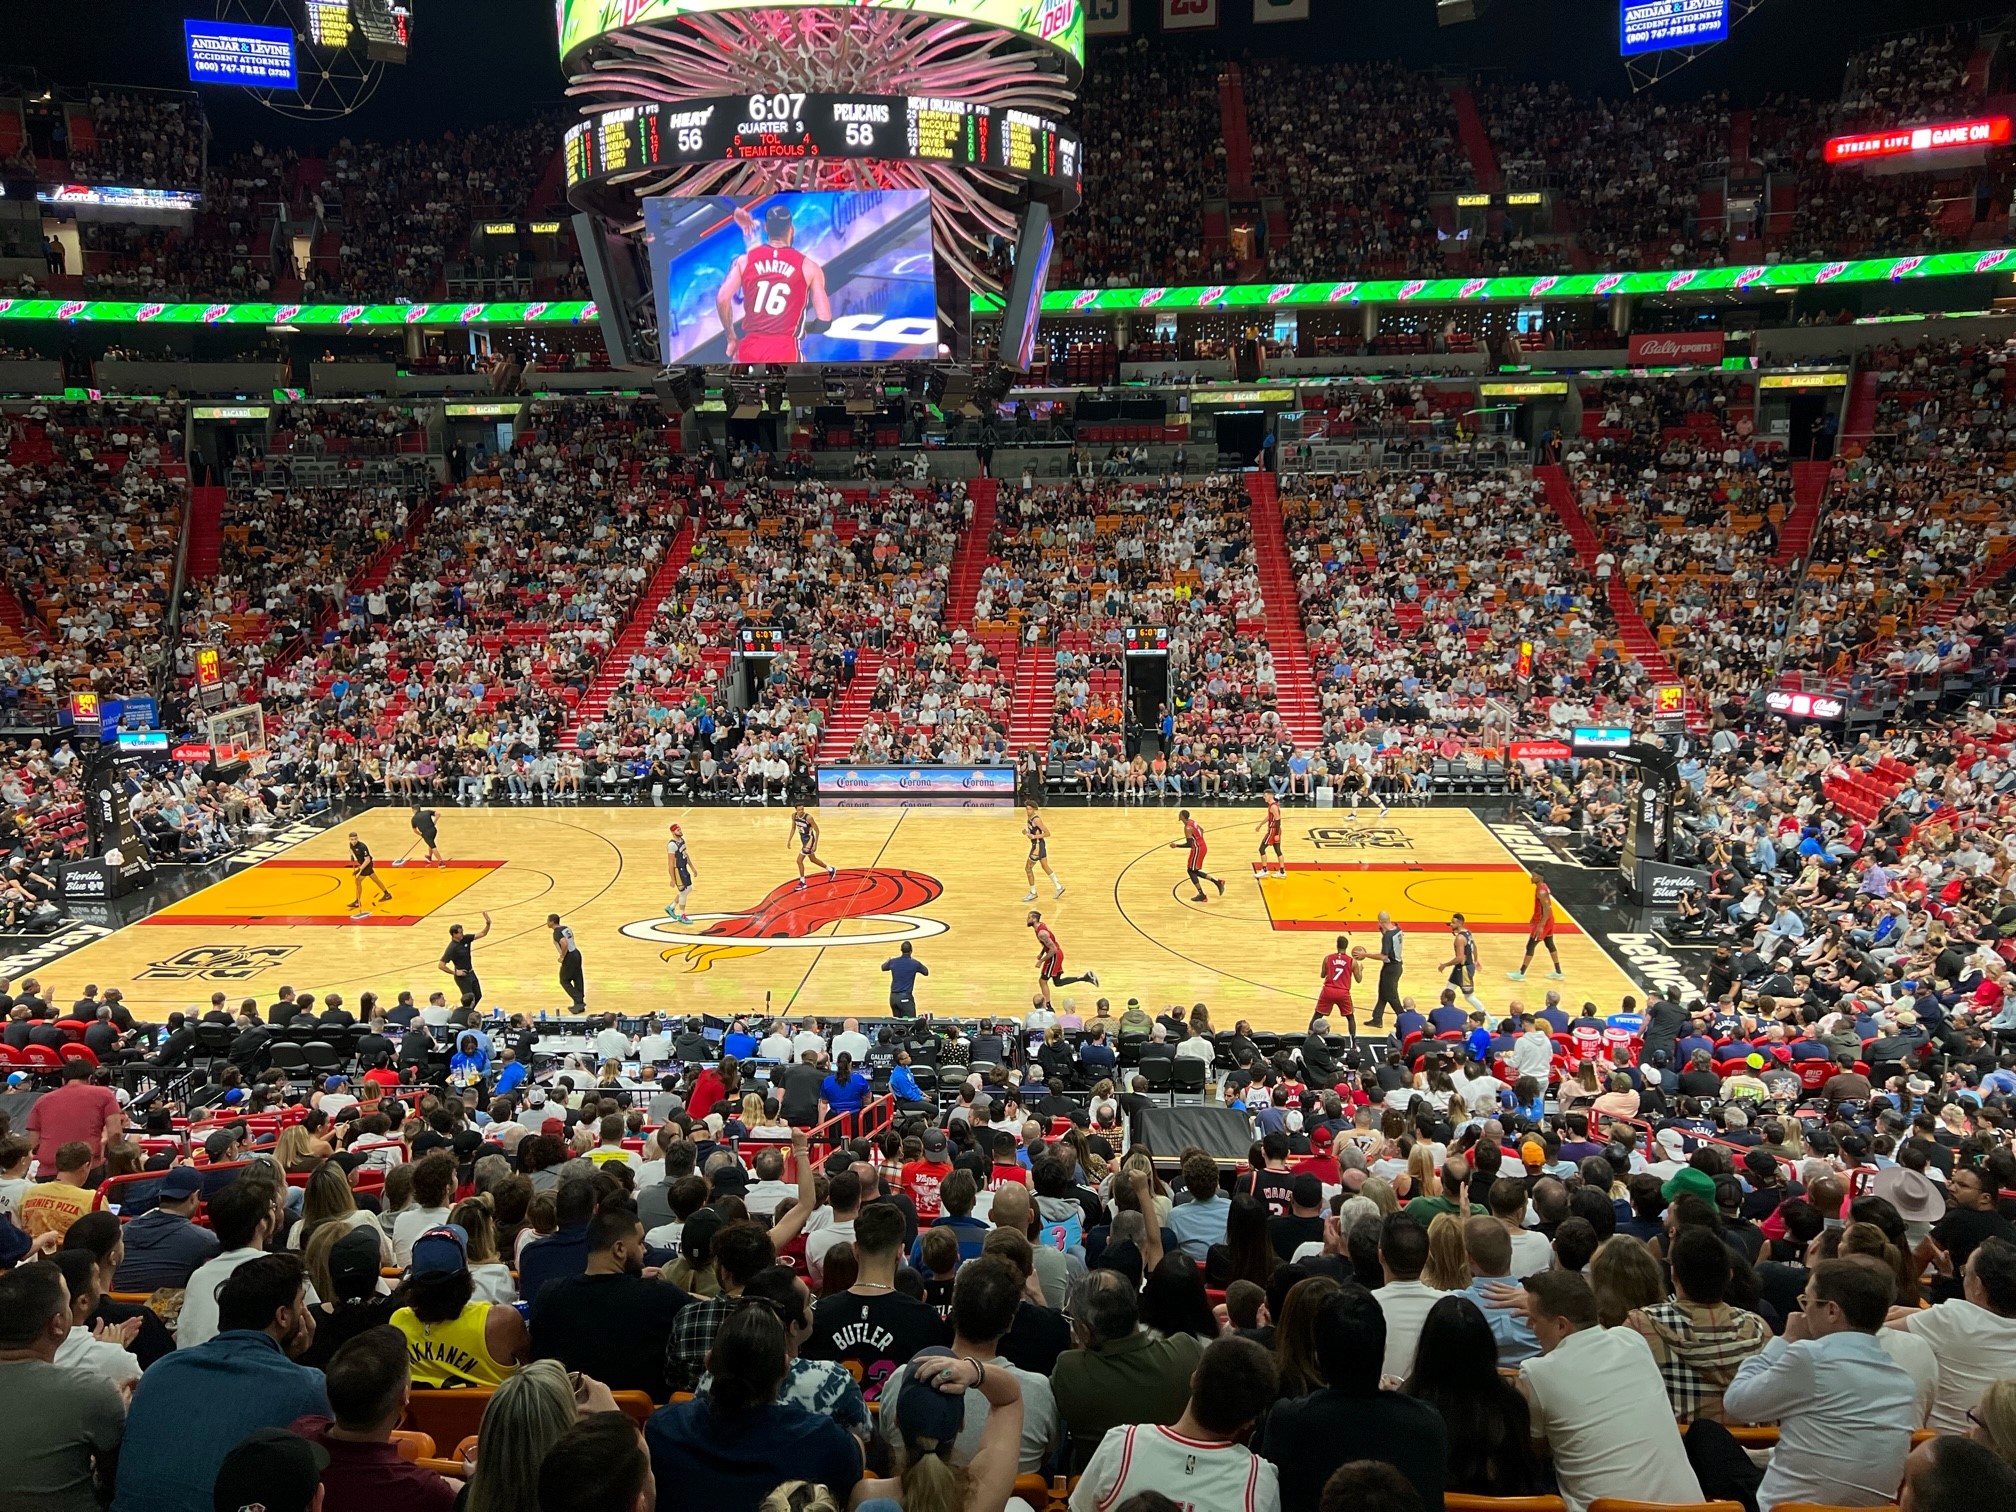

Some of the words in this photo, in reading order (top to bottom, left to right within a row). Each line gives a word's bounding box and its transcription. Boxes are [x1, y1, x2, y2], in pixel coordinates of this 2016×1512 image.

[1625, 5, 1673, 21] ANIDJAR
[1673, 2, 1682, 12] &
[1625, 18, 1670, 32] ACCIDENT
[1670, 10, 1722, 25] ATTORNEYS
[1627, 31, 1649, 44] (800)
[1651, 24, 1696, 40] 747-FREE
[192, 39, 240, 52] ANIDJAR
[241, 43, 249, 52] &
[250, 44, 290, 56] LEVINE
[193, 52, 238, 62] ACCIDENT
[240, 56, 290, 67] ATTORNEYS
[195, 61, 219, 72] (800)
[221, 64, 266, 75] 747-FREE
[749, 93, 806, 121] 6:07
[833, 103, 890, 123] PELICANS
[908, 96, 928, 110] NEW
[930, 98, 965, 114] ORLEANS
[975, 105, 990, 116] PTS
[670, 105, 715, 129] HEAT
[907, 109, 917, 119] 25
[919, 110, 950, 120] MURPHY
[737, 121, 789, 134] QUARTER
[796, 121, 804, 132] 3
[909, 119, 915, 127] 3
[919, 119, 960, 131] McCOLLUM
[678, 128, 703, 151] 56
[734, 134, 741, 146] 5
[760, 134, 780, 144] TOL
[803, 133, 810, 143] 4
[846, 123, 874, 145] 58
[907, 128, 917, 137] 22
[919, 129, 945, 139] NANCE
[946, 131, 958, 141] JR.
[1837, 140, 1880, 154] STREAM
[1884, 136, 1909, 148] LIVE
[1933, 127, 1969, 144] GAME
[1970, 124, 1990, 139] ON
[908, 137, 917, 147] 10
[919, 138, 945, 148] HAYES
[726, 148, 733, 158] 2
[739, 146, 768, 157] TEAM
[770, 145, 805, 156] FOULS
[811, 146, 818, 156] 3
[910, 147, 916, 156] 4
[919, 146, 953, 158] GRAHAM
[103, 196, 145, 206] Technology
[154, 198, 192, 209] Solutions
[754, 260, 795, 279] MARTIN
[754, 280, 791, 315] 16
[1639, 340, 1681, 357] Bally
[1681, 343, 1712, 352] SPORTS
[755, 630, 773, 638] 6:07
[202, 664, 217, 683] 24
[80, 704, 94, 714] 24
[1661, 699, 1678, 710] 24
[836, 777, 869, 789] Corona
[900, 777, 931, 788] Corona
[963, 777, 994, 788] Corona
[103, 802, 112, 822] AT&T
[1644, 801, 1654, 824] AT&T
[227, 820, 326, 864] HEAT
[1488, 823, 1582, 868] HEAT
[65, 871, 102, 880] Florida
[1652, 876, 1696, 886] Florida
[65, 881, 86, 891] Blue
[1652, 887, 1678, 897] Blue
[1333, 968, 1343, 980] 7
[1263, 1187, 1293, 1201] WADE
[56, 1201, 80, 1216] PIZZA
[1051, 1226, 1066, 1252] 3
[832, 1322, 894, 1352] BUTLER
